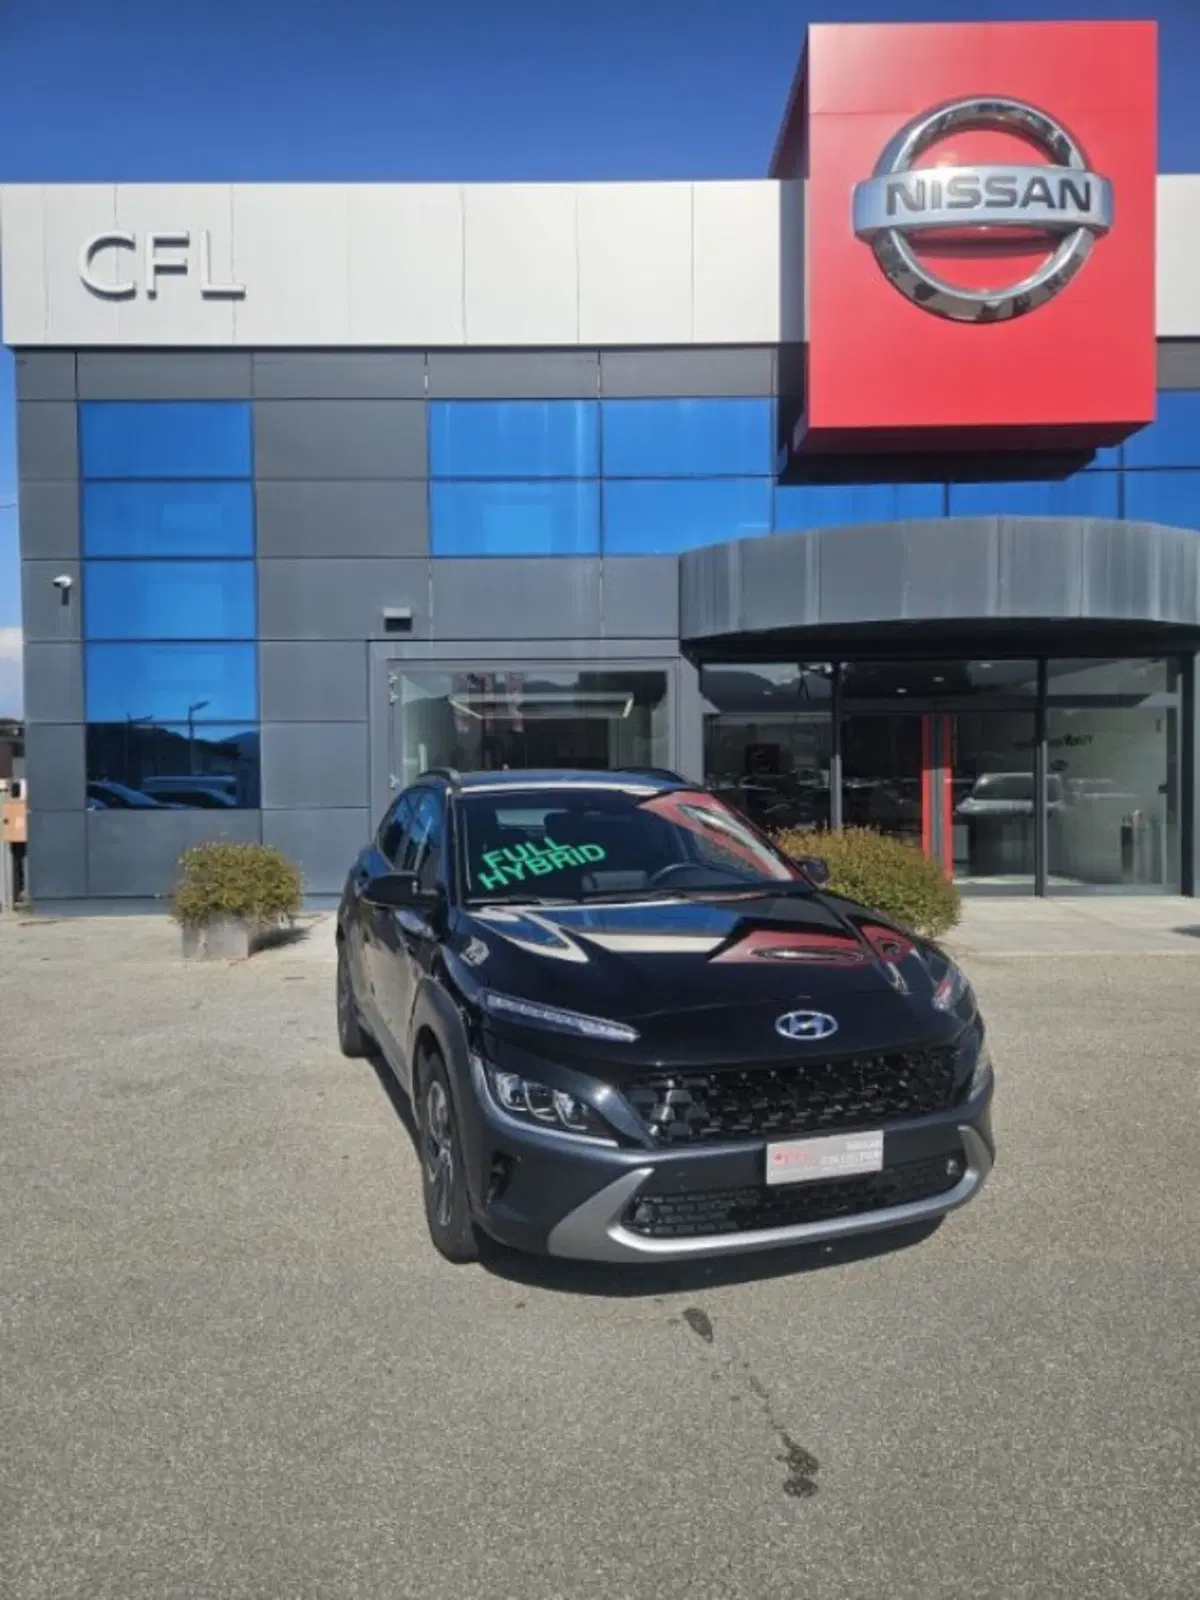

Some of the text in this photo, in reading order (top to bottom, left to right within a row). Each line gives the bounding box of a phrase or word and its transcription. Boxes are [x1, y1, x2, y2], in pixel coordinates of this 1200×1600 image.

[886, 175, 1091, 216] NISSAN
[79, 229, 247, 302] CFL
[477, 844, 606, 889] HYBRID
[482, 836, 572, 868] FULL
